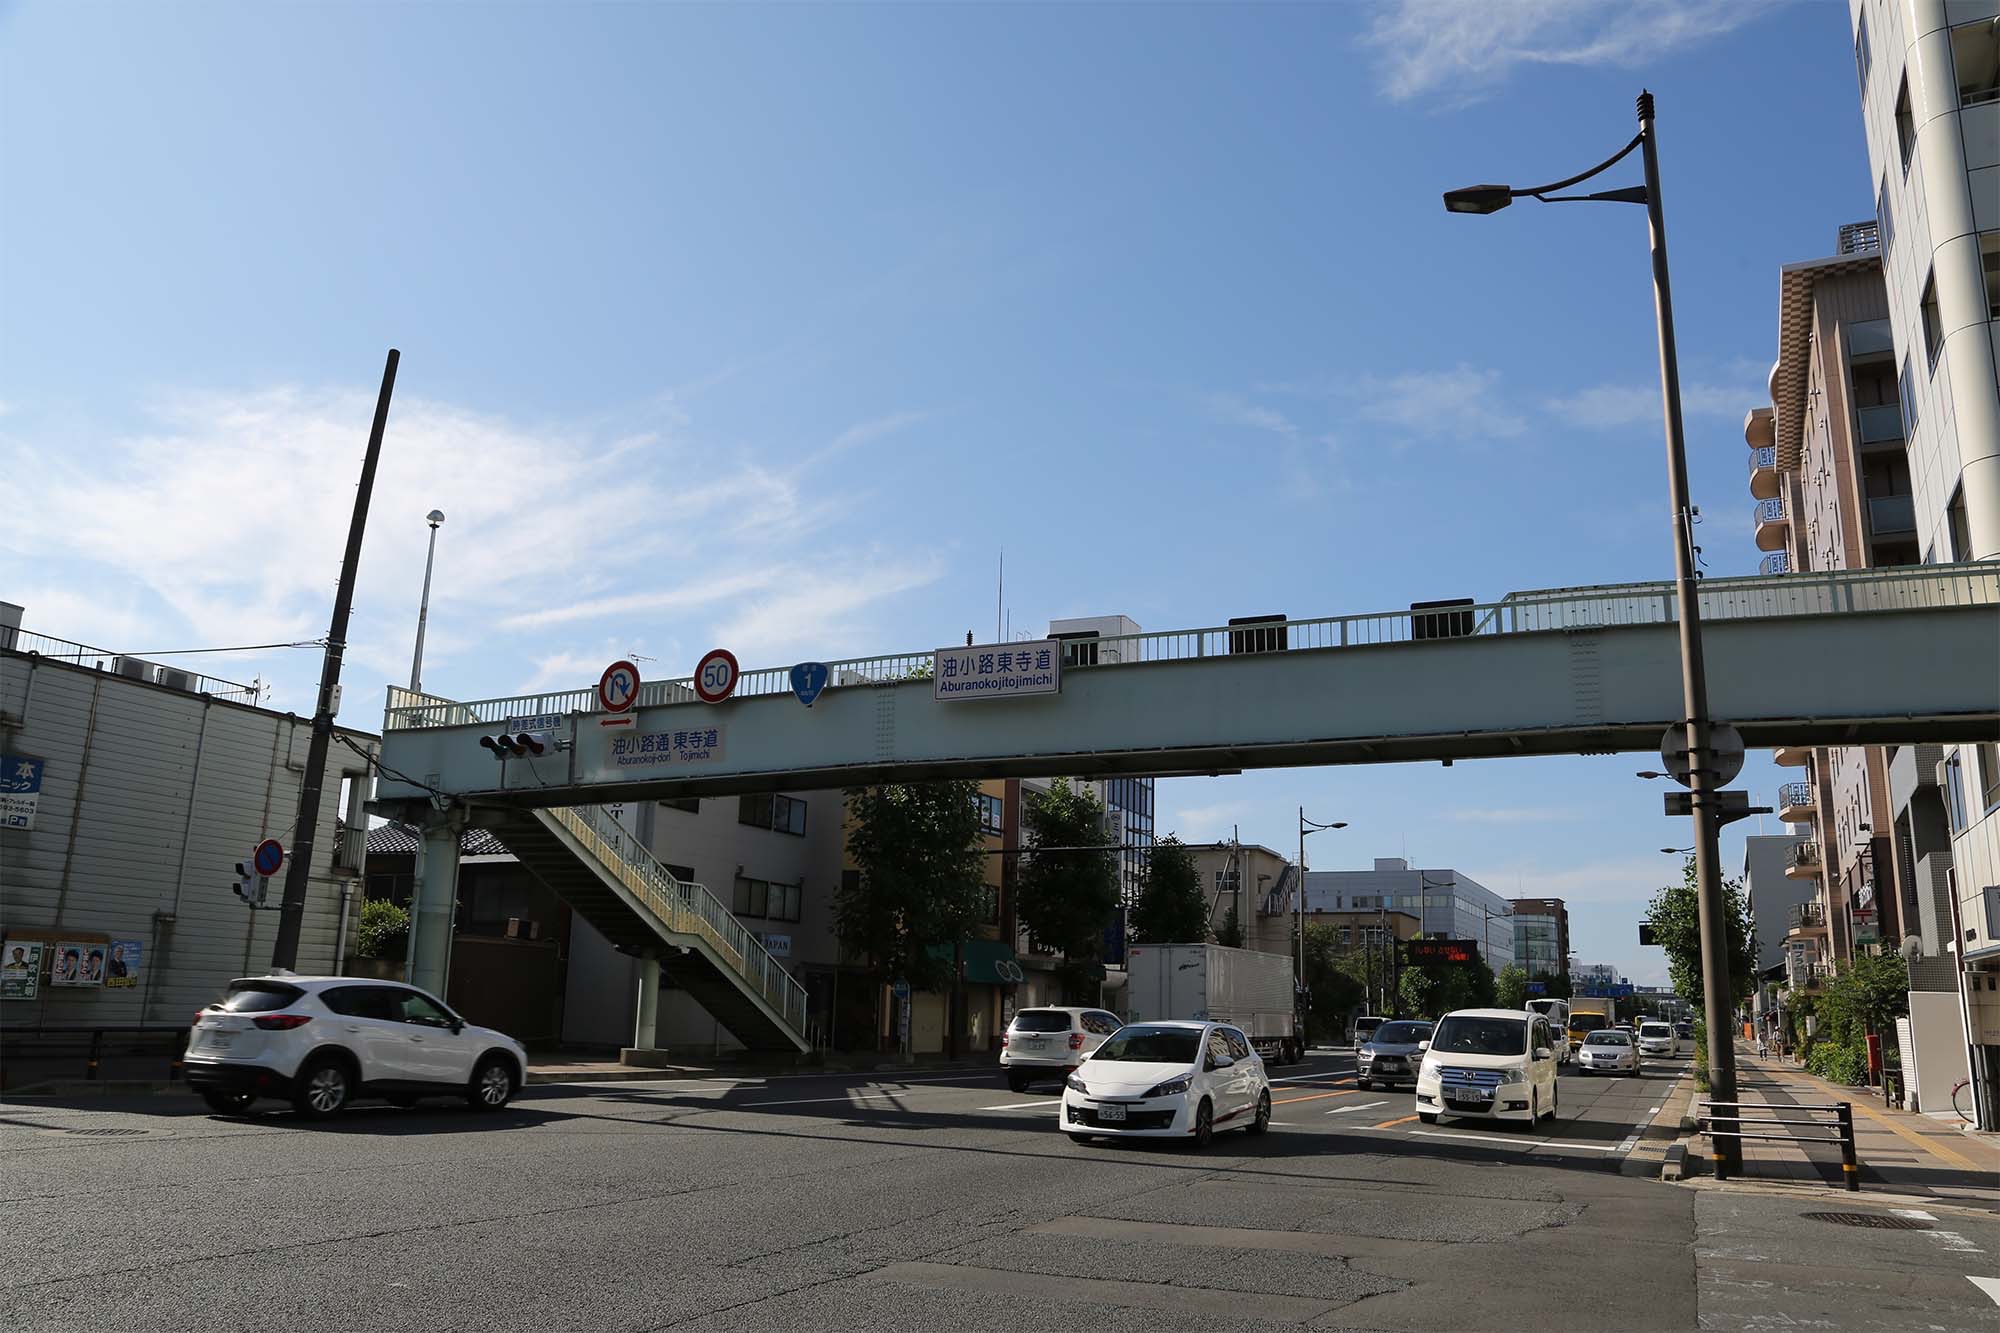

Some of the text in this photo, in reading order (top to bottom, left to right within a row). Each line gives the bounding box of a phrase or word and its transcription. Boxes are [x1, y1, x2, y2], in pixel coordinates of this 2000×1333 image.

[942, 650, 1051, 678] 油小路東寺道
[704, 664, 728, 688] 50
[804, 673, 811, 688] 1
[940, 673, 1053, 692] Aburanokojitojimichi
[612, 730, 718, 755] 油小路通 東寺道
[617, 751, 710, 766] Aburanokoji-dori Tojimichi
